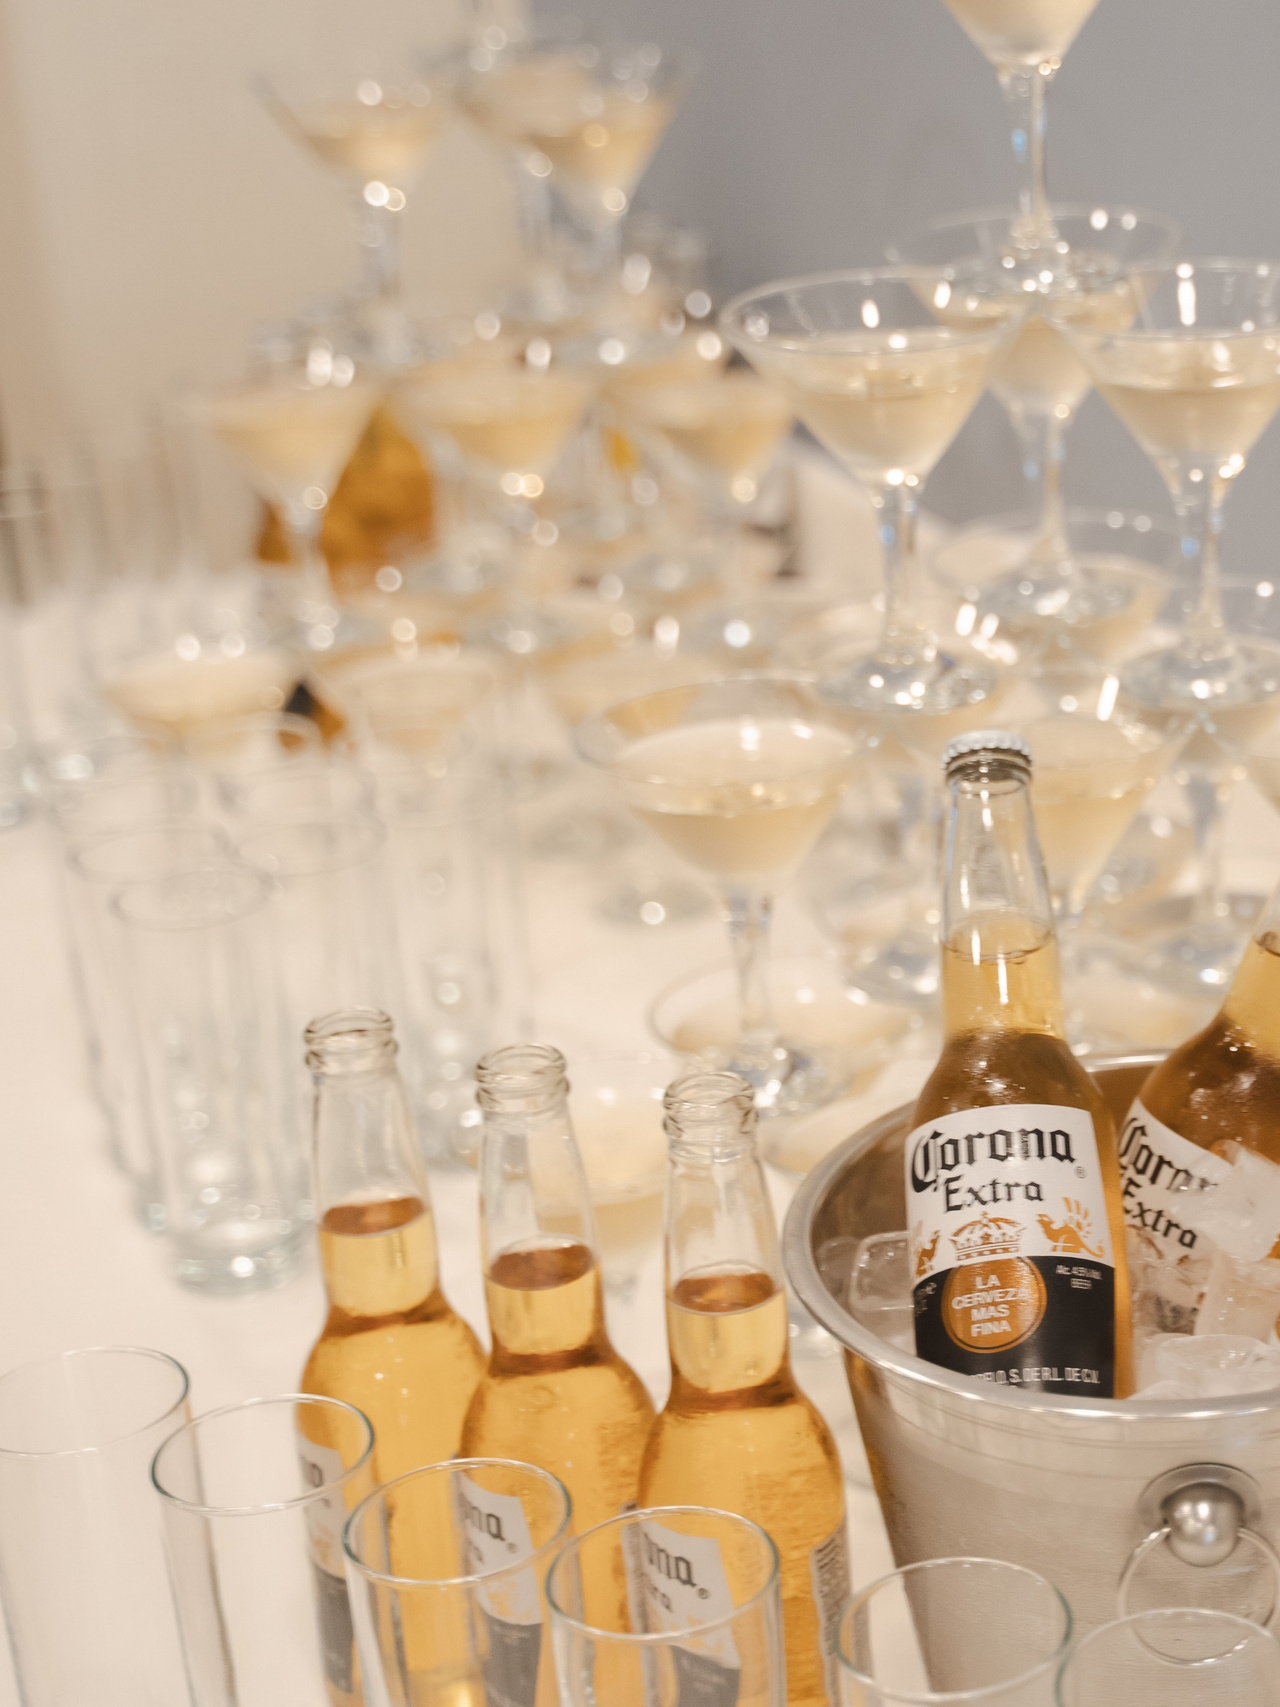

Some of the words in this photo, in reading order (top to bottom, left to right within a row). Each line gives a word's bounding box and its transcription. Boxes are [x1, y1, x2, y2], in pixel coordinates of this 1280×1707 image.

[911, 1127, 1076, 1193] Corona
[944, 1173, 1045, 1214] Extra
[975, 1274, 1001, 1289] LA
[951, 1287, 1031, 1310] CERVEZA
[971, 1304, 1011, 1321] MAS
[971, 1320, 1012, 1337] FINA
